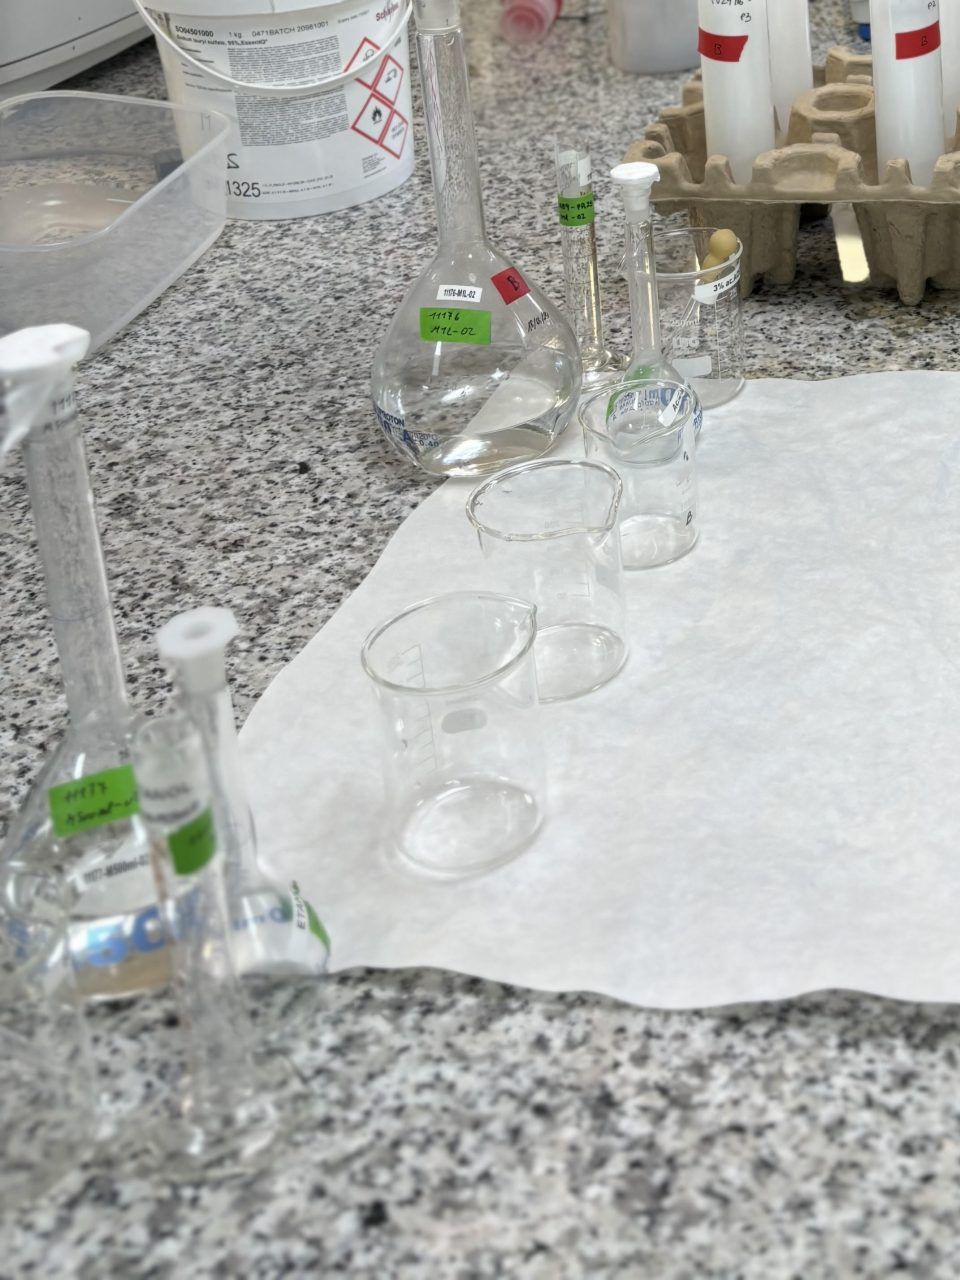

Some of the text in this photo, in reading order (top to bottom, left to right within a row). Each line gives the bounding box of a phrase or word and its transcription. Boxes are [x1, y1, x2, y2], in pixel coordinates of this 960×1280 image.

[927, 0, 937, 10] P2
[740, 12, 752, 23] P3
[226, 179, 261, 198] 1325
